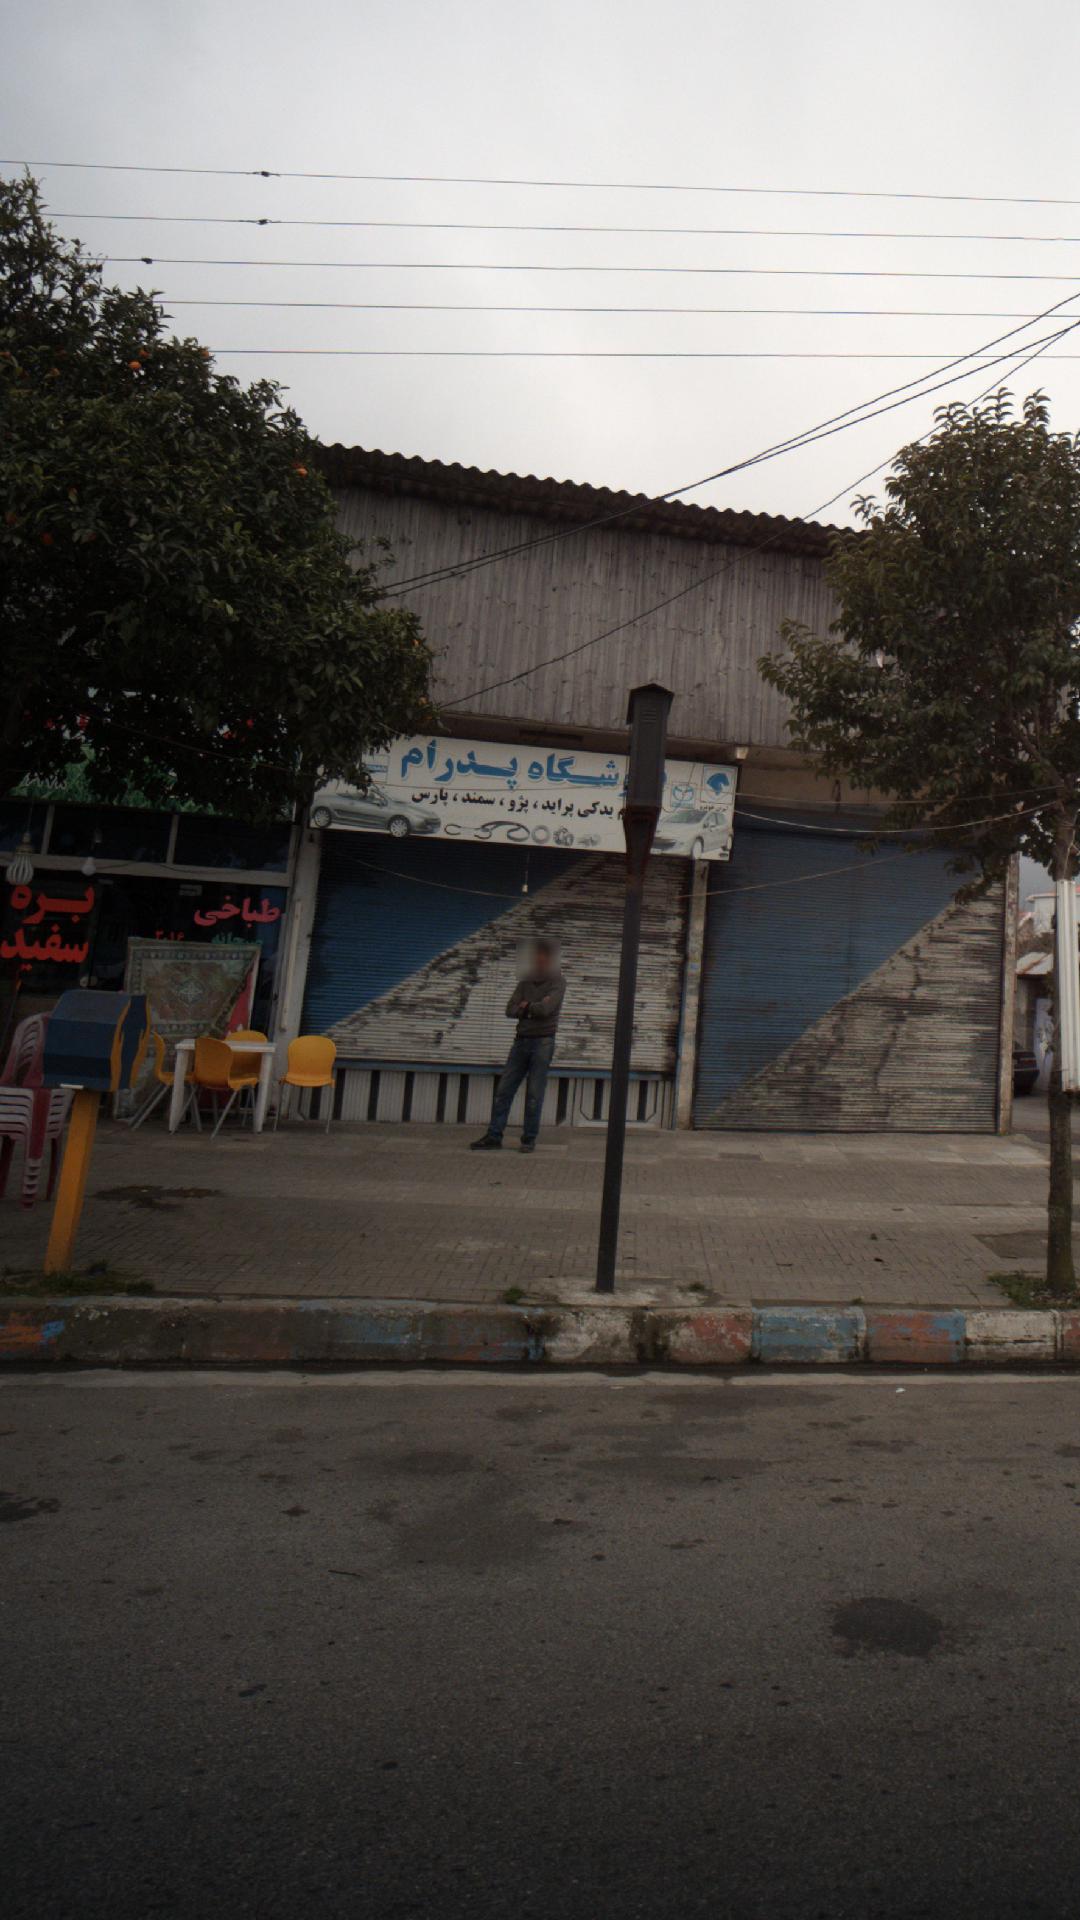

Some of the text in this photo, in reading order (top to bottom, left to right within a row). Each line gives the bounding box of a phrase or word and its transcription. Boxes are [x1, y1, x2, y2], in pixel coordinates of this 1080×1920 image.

[401, 738, 519, 790] پدرام
[411, 787, 448, 806] پارس
[577, 801, 614, 820] یدکی
[11, 884, 95, 925] بره
[194, 896, 281, 928] طباخی
[0, 922, 89, 971] سفید
